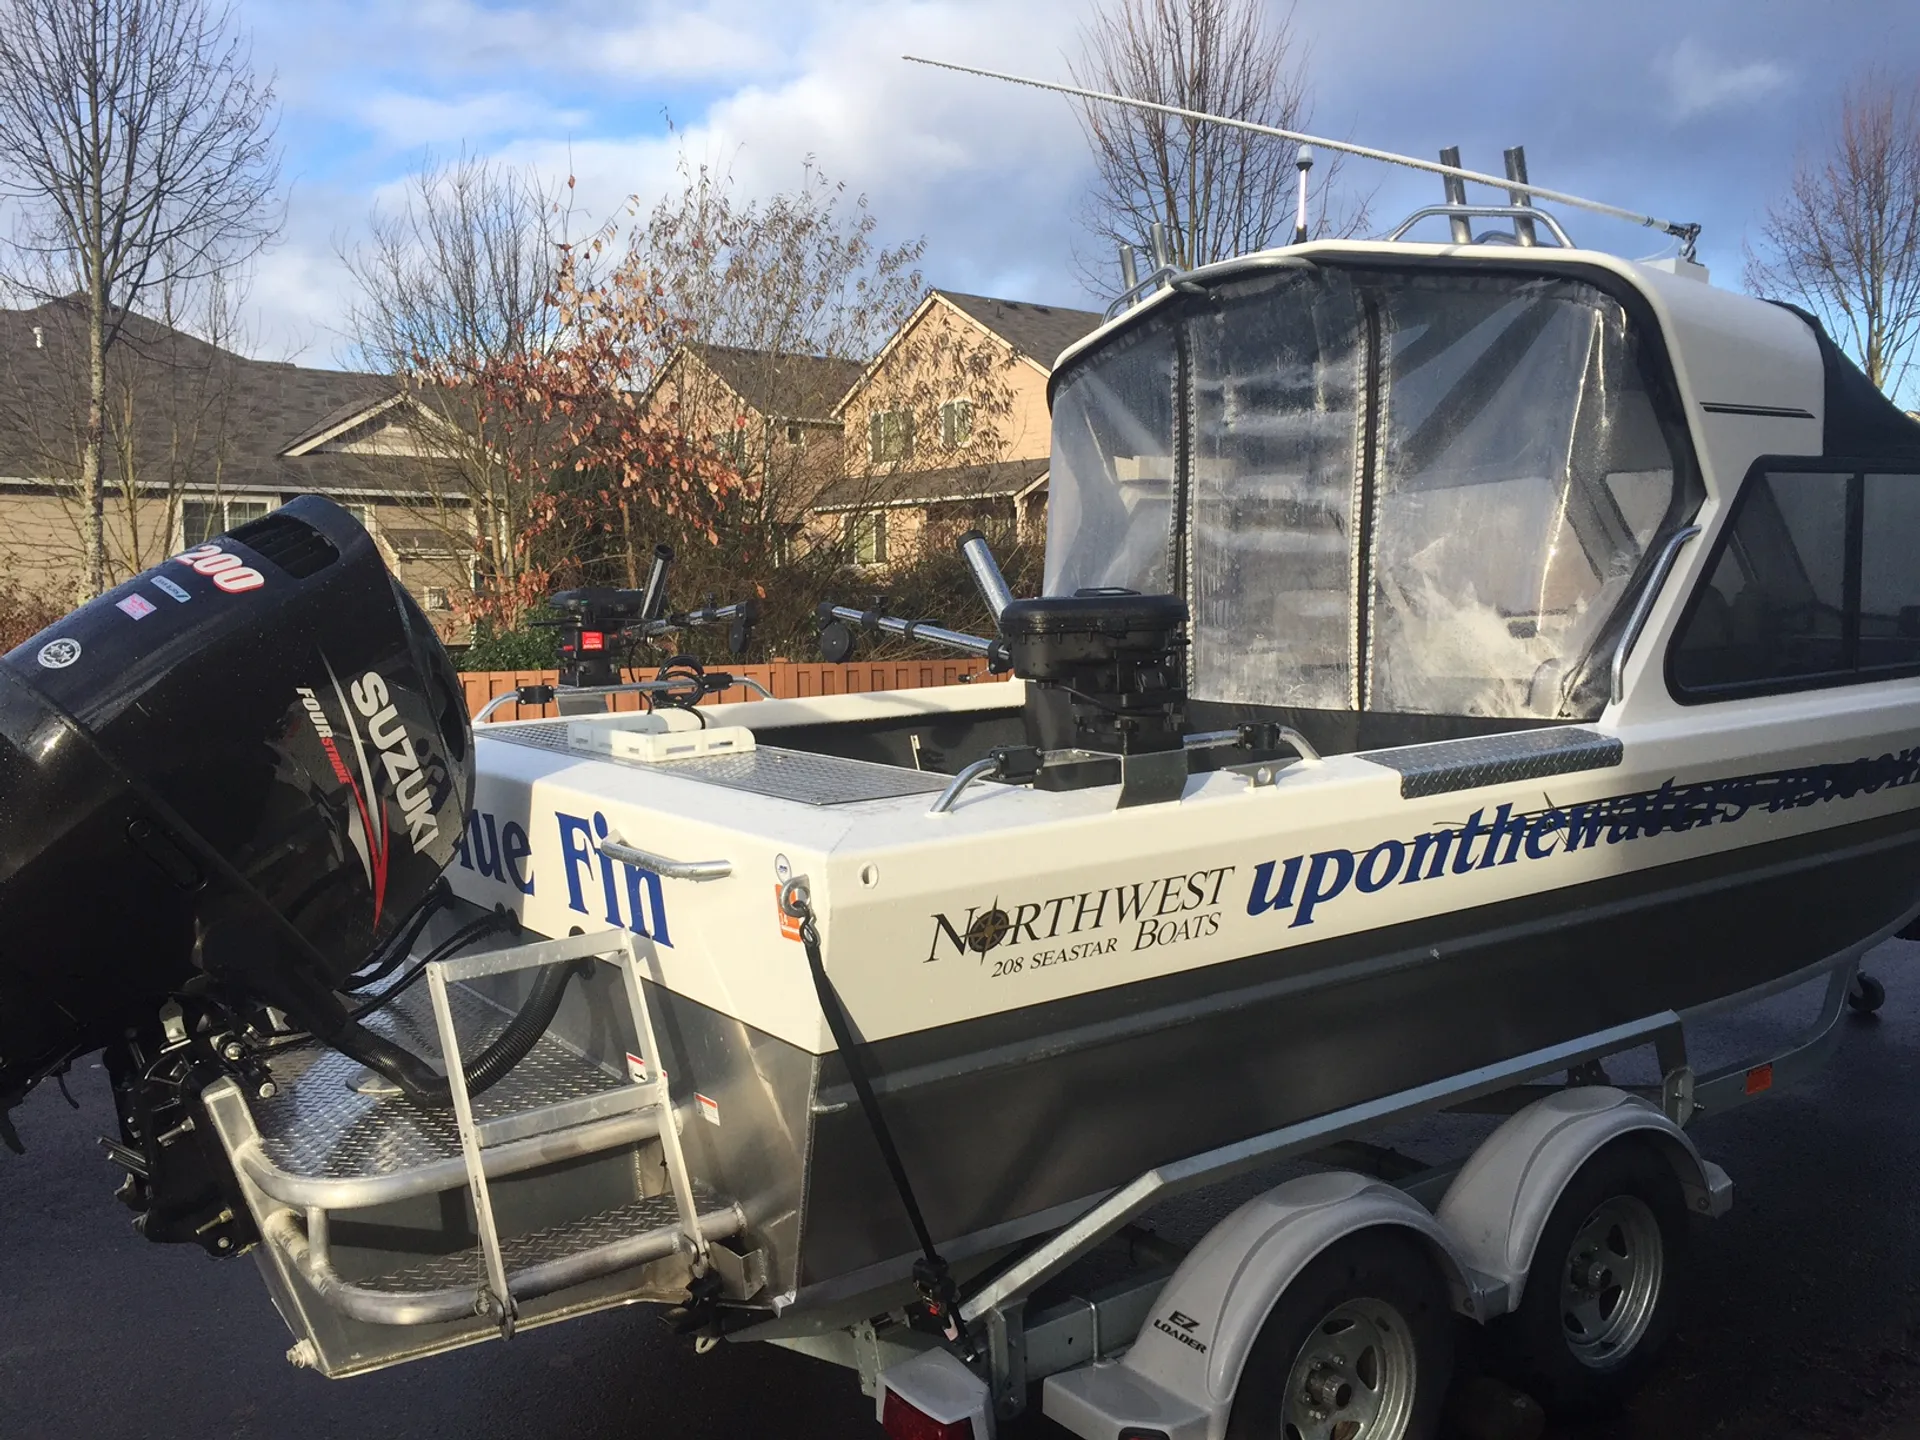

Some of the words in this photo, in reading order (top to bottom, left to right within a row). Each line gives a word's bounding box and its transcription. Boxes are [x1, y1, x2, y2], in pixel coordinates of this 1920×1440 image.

[175, 545, 265, 594] 200
[350, 671, 440, 854] SUZUKI
[554, 811, 674, 949] Fin
[922, 866, 1236, 966] NORTHWEST
[1131, 911, 1222, 952] BOATS
[991, 957, 1024, 978] 208
[1030, 937, 1118, 970] SEASTAR
[1153, 1318, 1207, 1354] LOADER
[1168, 1310, 1200, 1334] EZ
